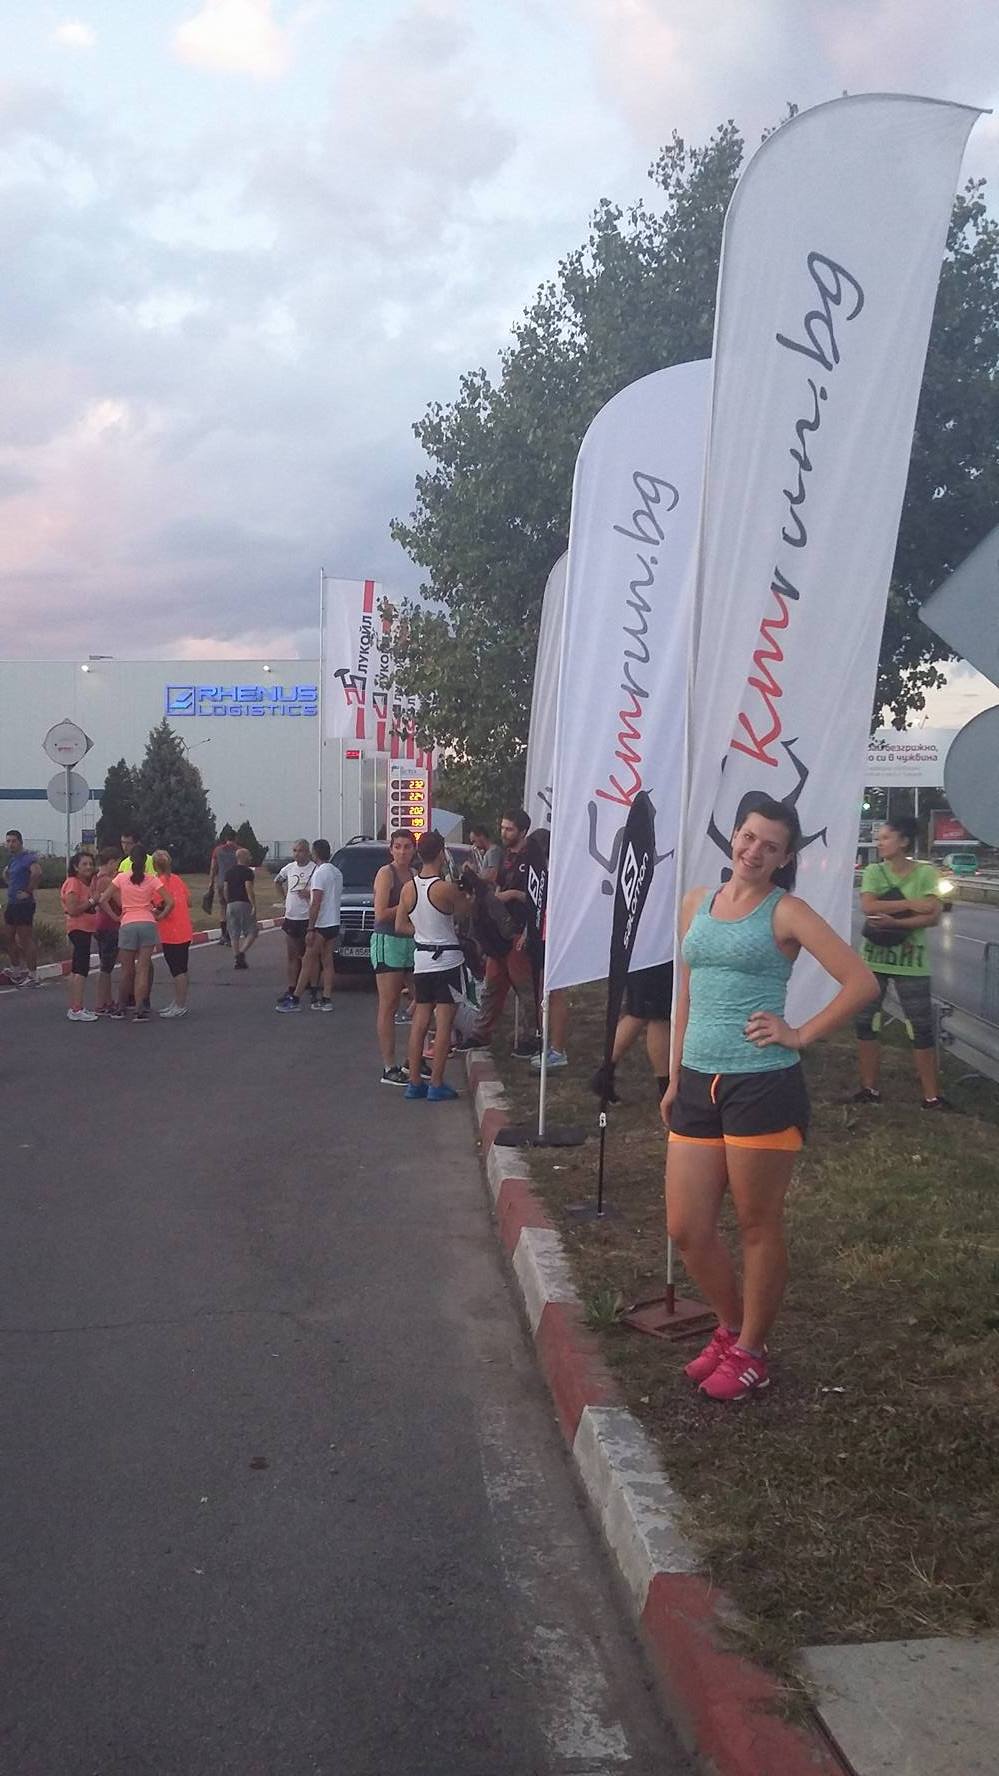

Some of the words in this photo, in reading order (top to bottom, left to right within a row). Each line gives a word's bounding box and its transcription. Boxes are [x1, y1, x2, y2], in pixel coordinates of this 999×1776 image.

[358, 614, 373, 675] ЛУКОЙЛ
[198, 685, 318, 703] RHENUS
[198, 704, 318, 717] LOGISTICS
